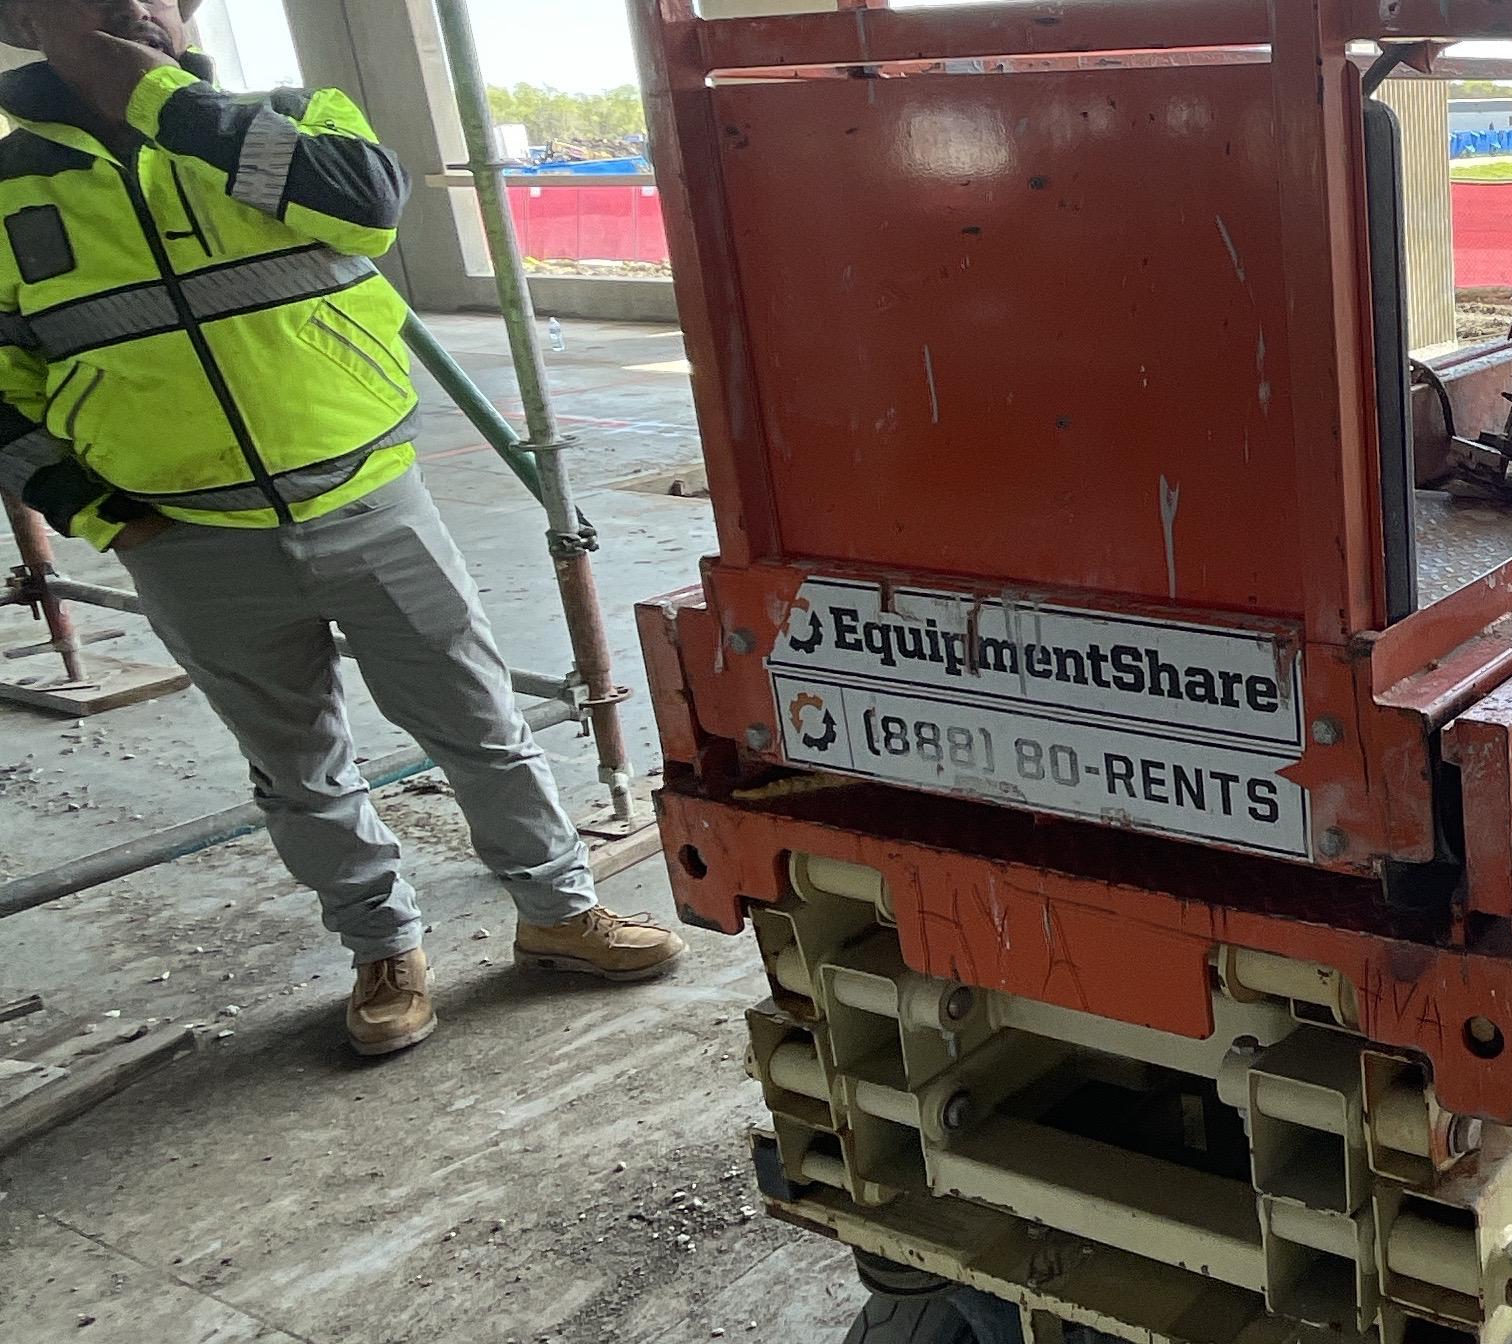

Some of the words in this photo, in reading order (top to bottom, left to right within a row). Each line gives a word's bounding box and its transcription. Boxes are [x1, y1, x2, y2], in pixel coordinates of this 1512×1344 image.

[829, 606, 1279, 714] EquipmentShare
[863, 707, 995, 774] (888)
[1014, 738, 1279, 823] 80-RENTS
